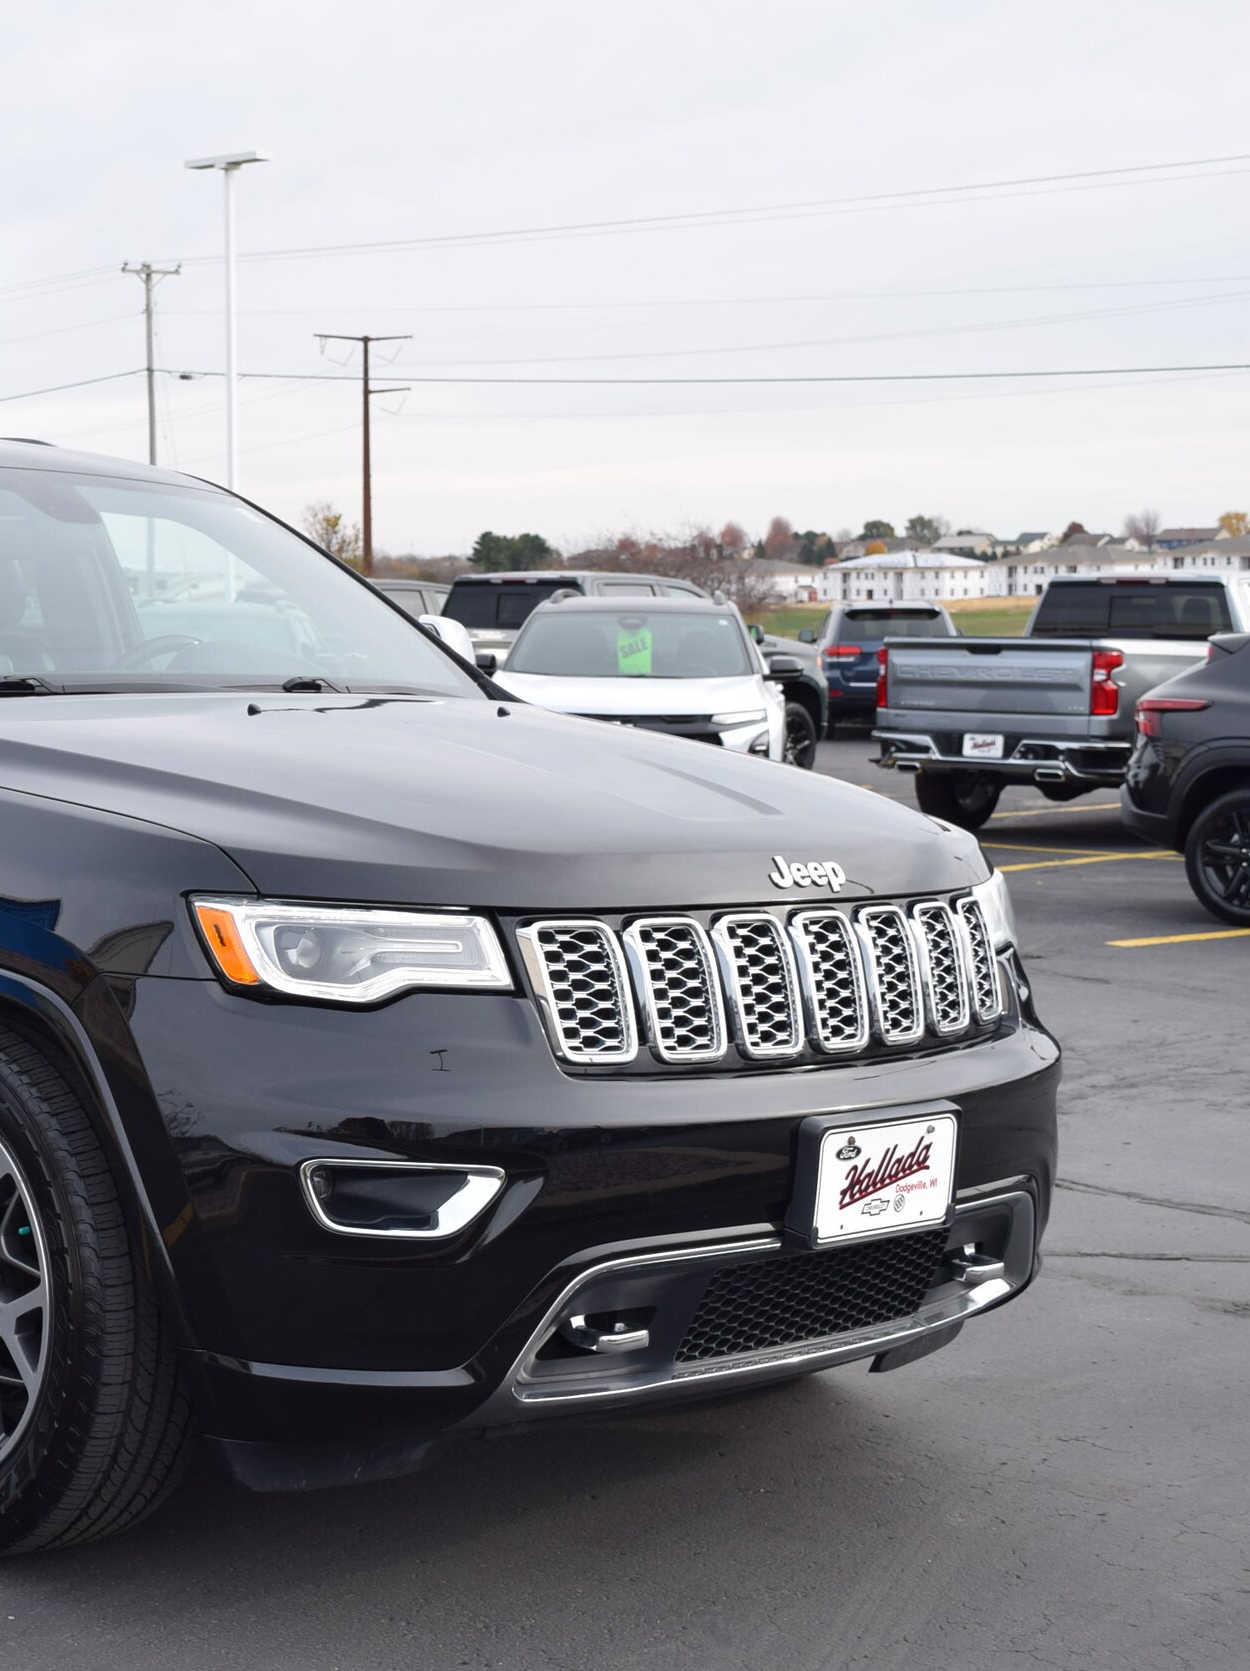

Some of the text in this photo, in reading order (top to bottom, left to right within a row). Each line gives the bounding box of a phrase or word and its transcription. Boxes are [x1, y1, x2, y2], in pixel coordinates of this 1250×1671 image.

[620, 637, 649, 659] SALE
[768, 855, 846, 894] Jeep
[839, 1135, 932, 1209] Hallada
[895, 1178, 938, 1194] Dodgeville, WI
